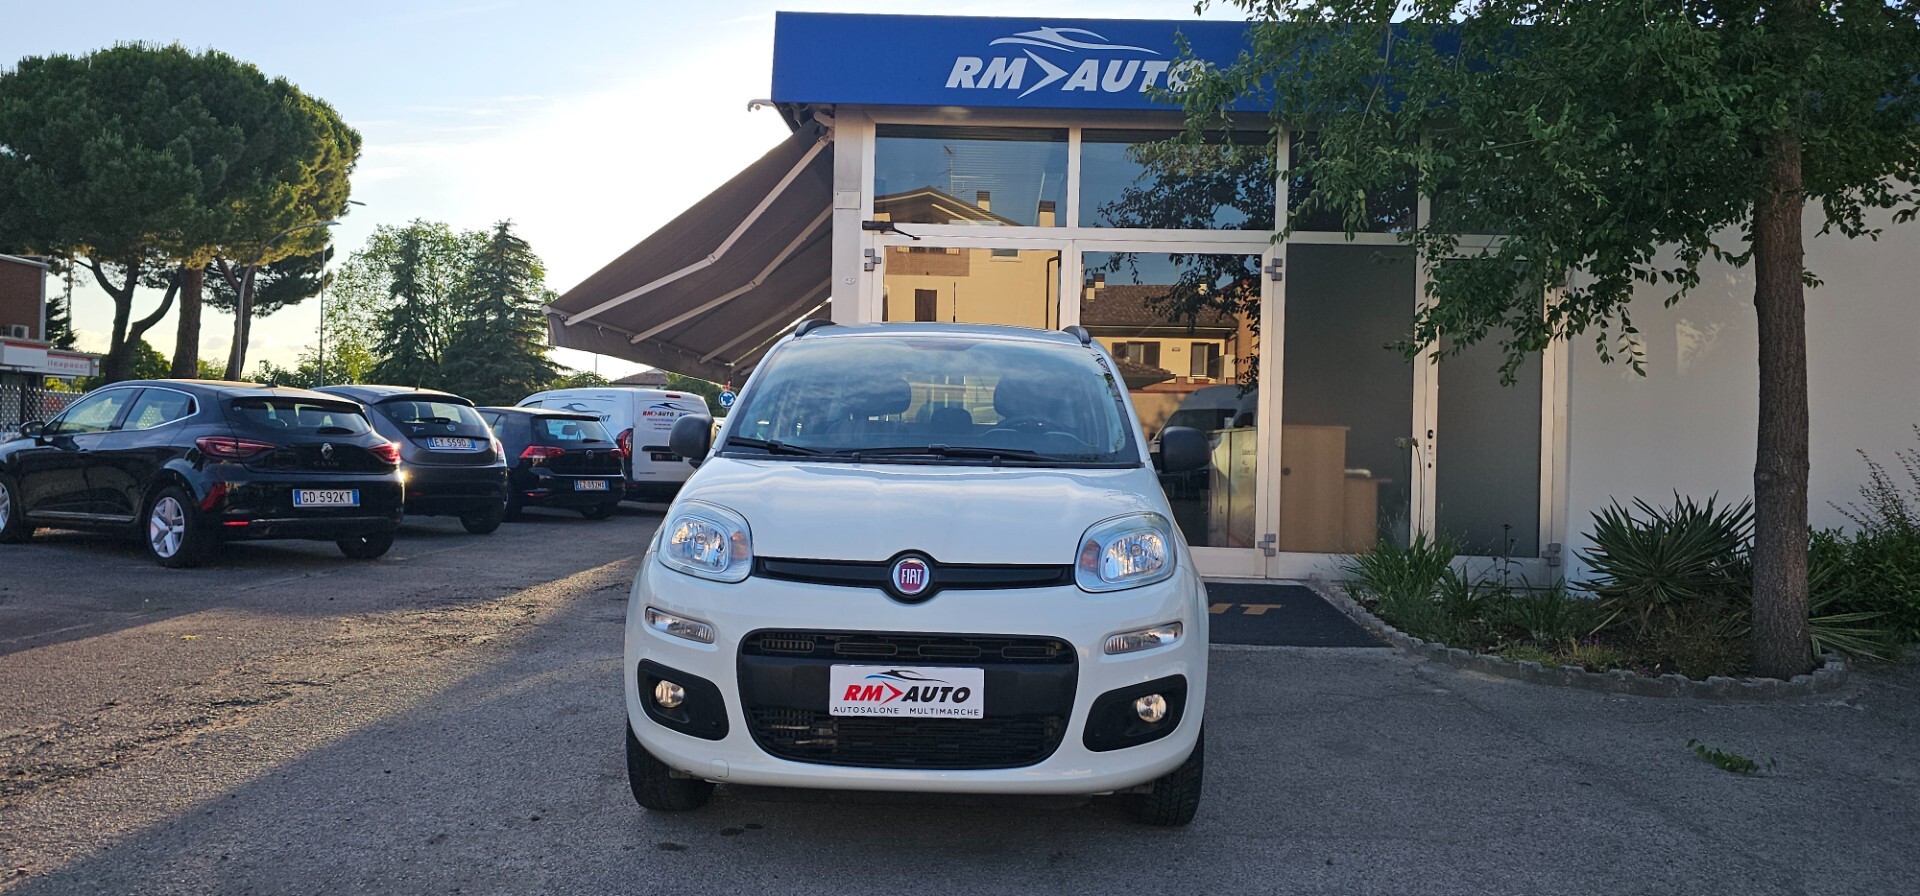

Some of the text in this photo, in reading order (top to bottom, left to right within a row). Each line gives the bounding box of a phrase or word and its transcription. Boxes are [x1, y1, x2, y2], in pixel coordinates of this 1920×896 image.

[945, 56, 1206, 94] RM AUTO
[302, 492, 351, 503] GD 592KT
[901, 568, 923, 585] FIAT
[843, 685, 971, 704] RM AUTO
[833, 706, 980, 716] AUTOSALONE MULTIMARCHE
